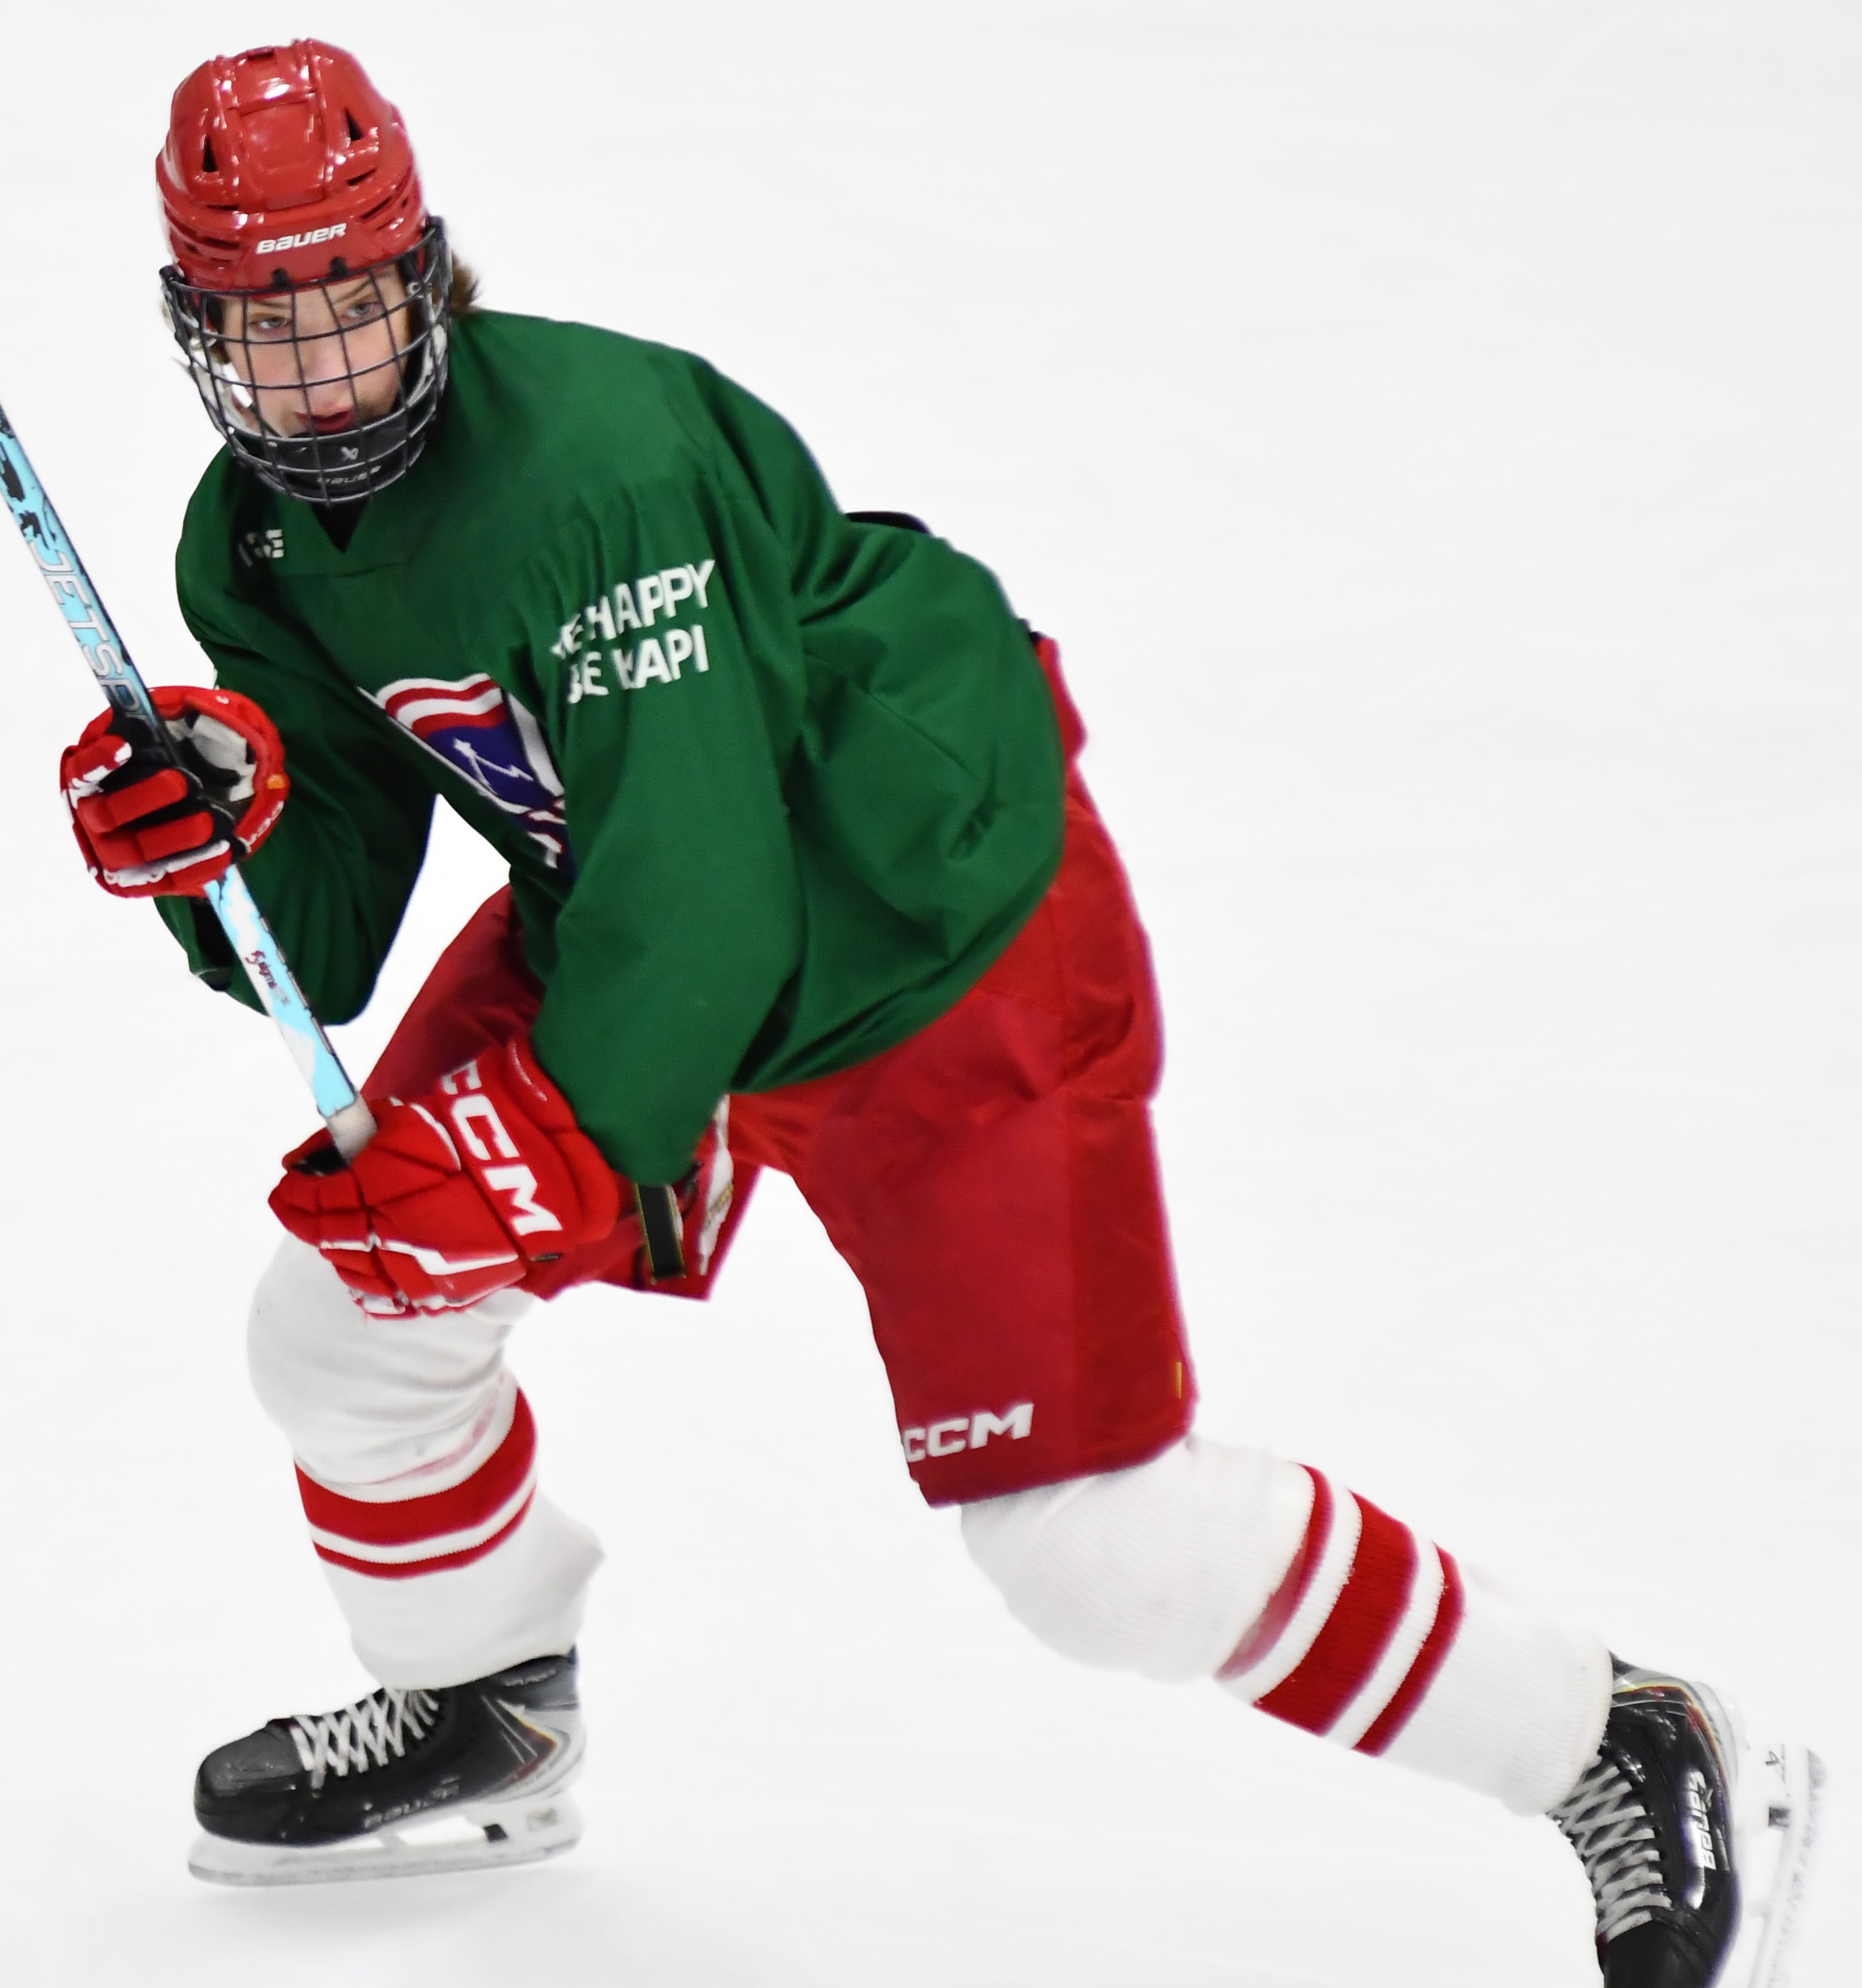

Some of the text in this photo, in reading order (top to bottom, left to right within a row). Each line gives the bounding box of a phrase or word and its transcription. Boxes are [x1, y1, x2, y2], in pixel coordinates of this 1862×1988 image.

[256, 223, 347, 255] BAUER
[585, 558, 715, 641] HAPPY
[441, 1060, 563, 1236] CCM
[903, 1403, 1034, 1463] CCM
